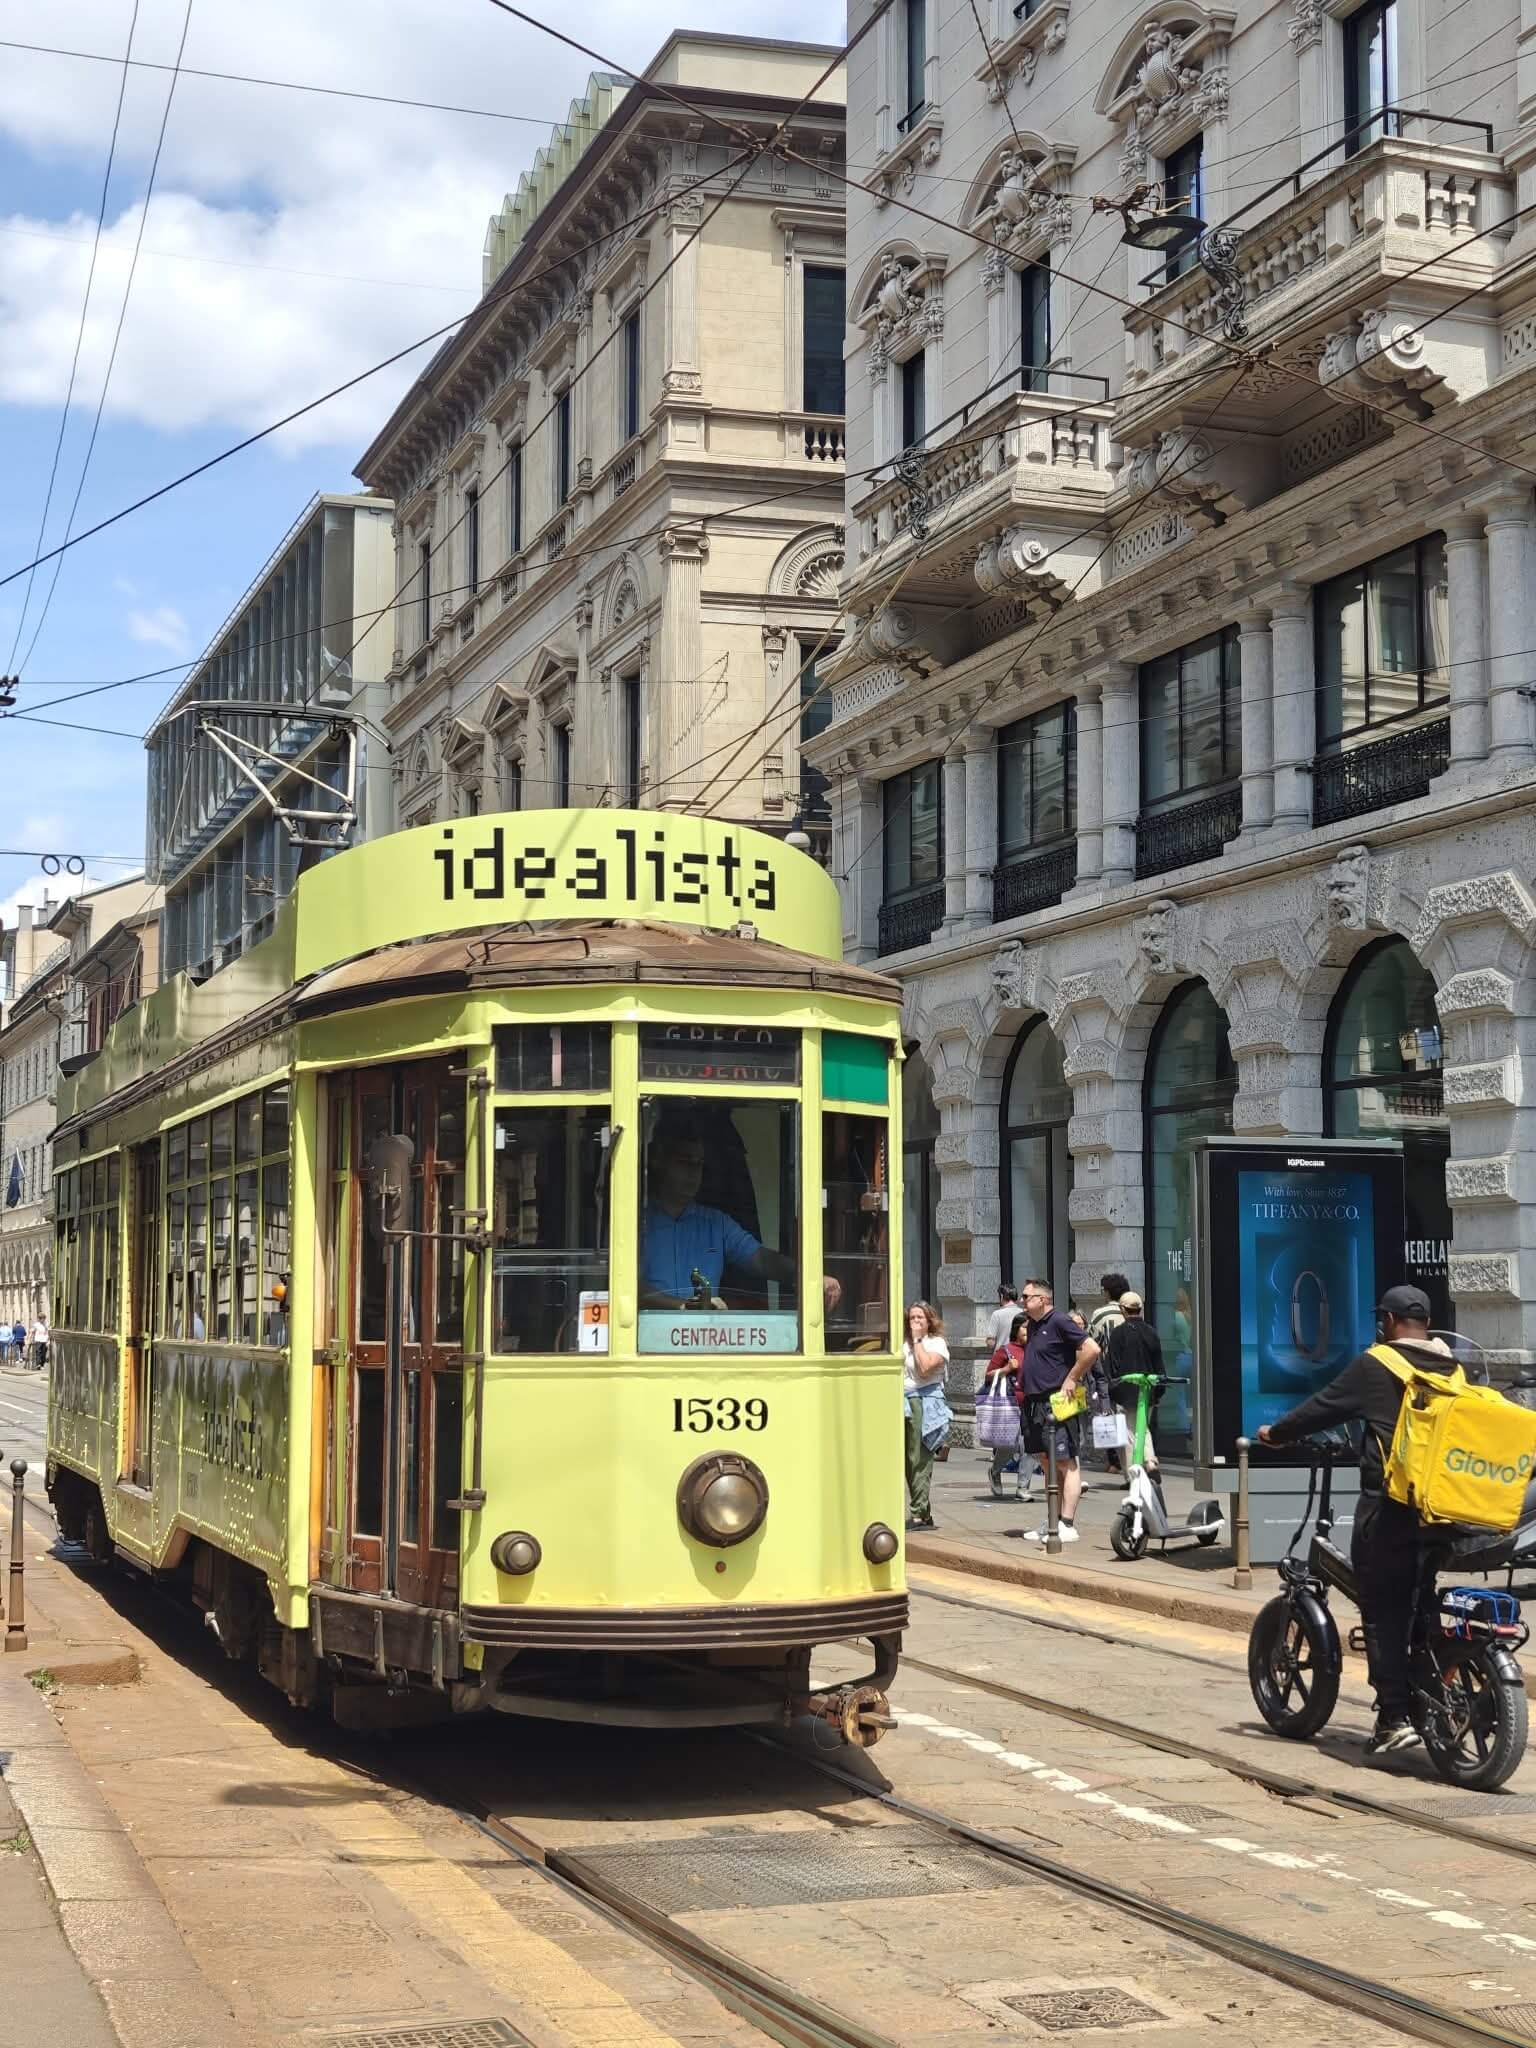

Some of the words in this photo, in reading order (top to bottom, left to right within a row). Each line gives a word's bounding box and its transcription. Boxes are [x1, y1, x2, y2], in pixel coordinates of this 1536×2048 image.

[434, 827, 776, 911] idealista
[550, 1026, 562, 1087] 1
[1167, 1250, 1183, 1271] THE
[591, 1306, 601, 1323] 9
[591, 1330, 599, 1346] 1
[671, 1327, 745, 1346] CENTRALE
[749, 1327, 767, 1346] FS
[672, 1397, 769, 1433] 1539
